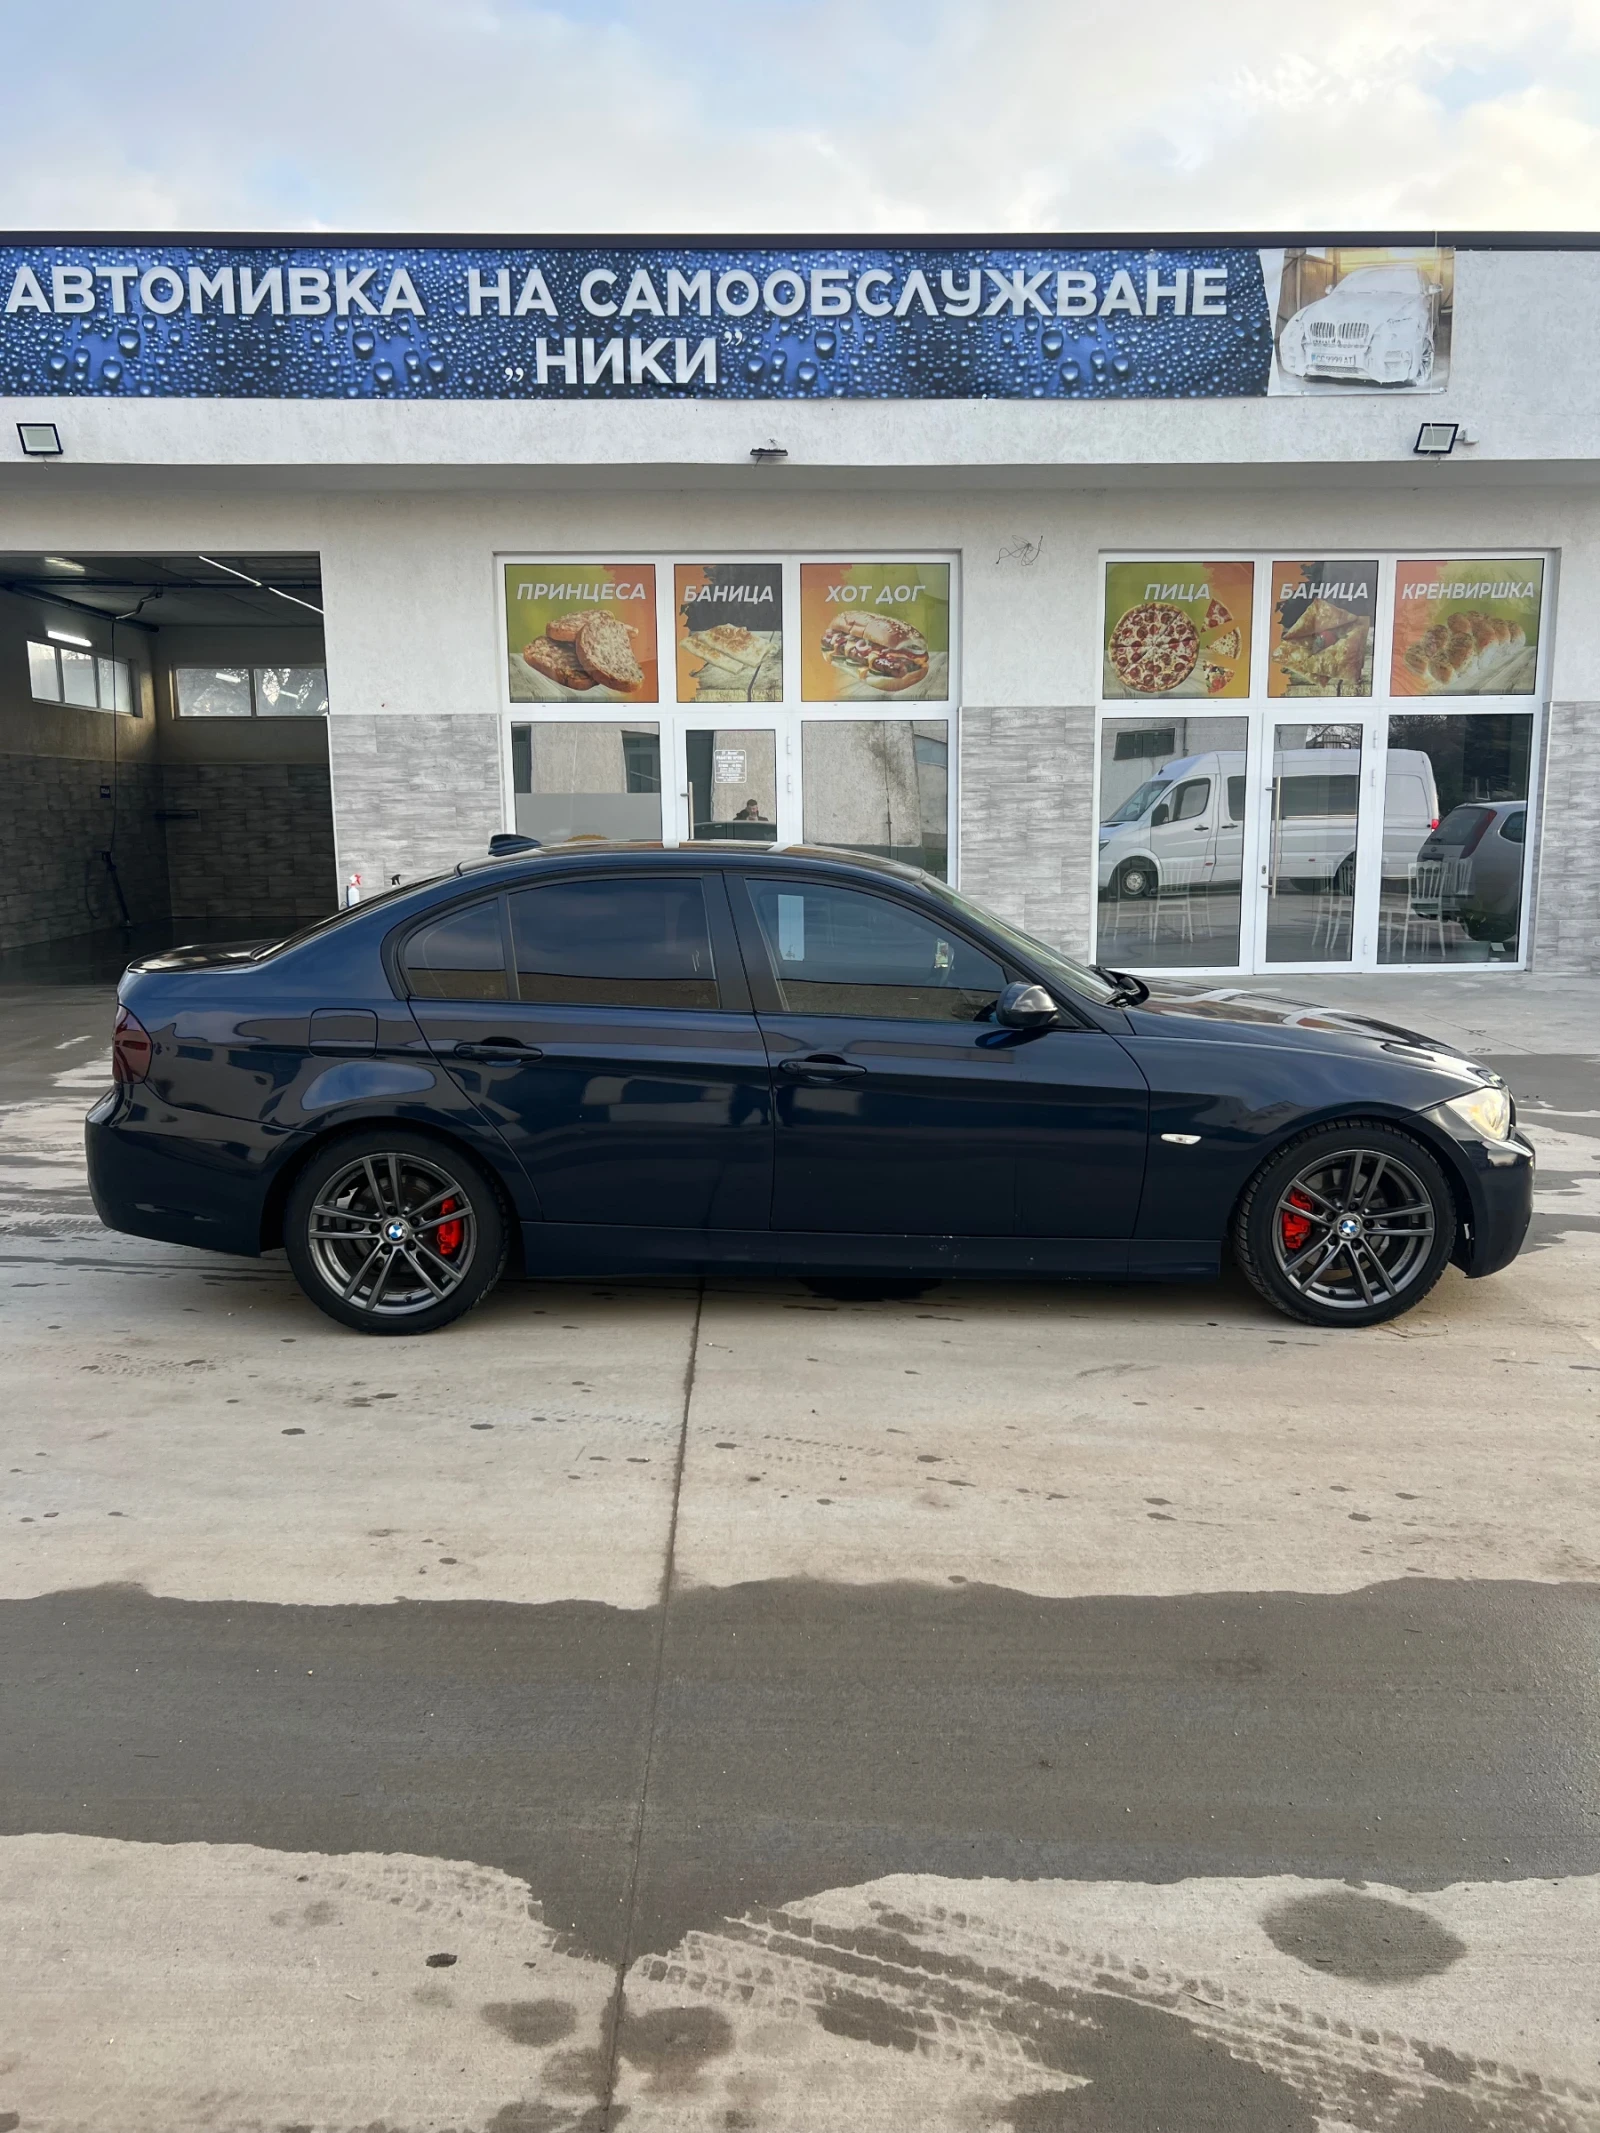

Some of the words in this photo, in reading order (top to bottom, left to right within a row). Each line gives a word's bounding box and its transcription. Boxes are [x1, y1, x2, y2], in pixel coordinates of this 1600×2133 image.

[4, 267, 427, 316] АВТОМИВКА
[467, 268, 559, 316] НА
[579, 267, 1228, 317] САМООБСЛУЖВАНЕ
[516, 582, 646, 602] ПРИНЦЕСА
[684, 585, 774, 604] БАНИЦА
[826, 585, 873, 603] ХОТ
[875, 585, 926, 605] ДОГ
[1143, 583, 1211, 602] ПИЦА
[1279, 582, 1369, 601] БАНИЦА
[1401, 581, 1534, 600] КРЕНВИРШКА
